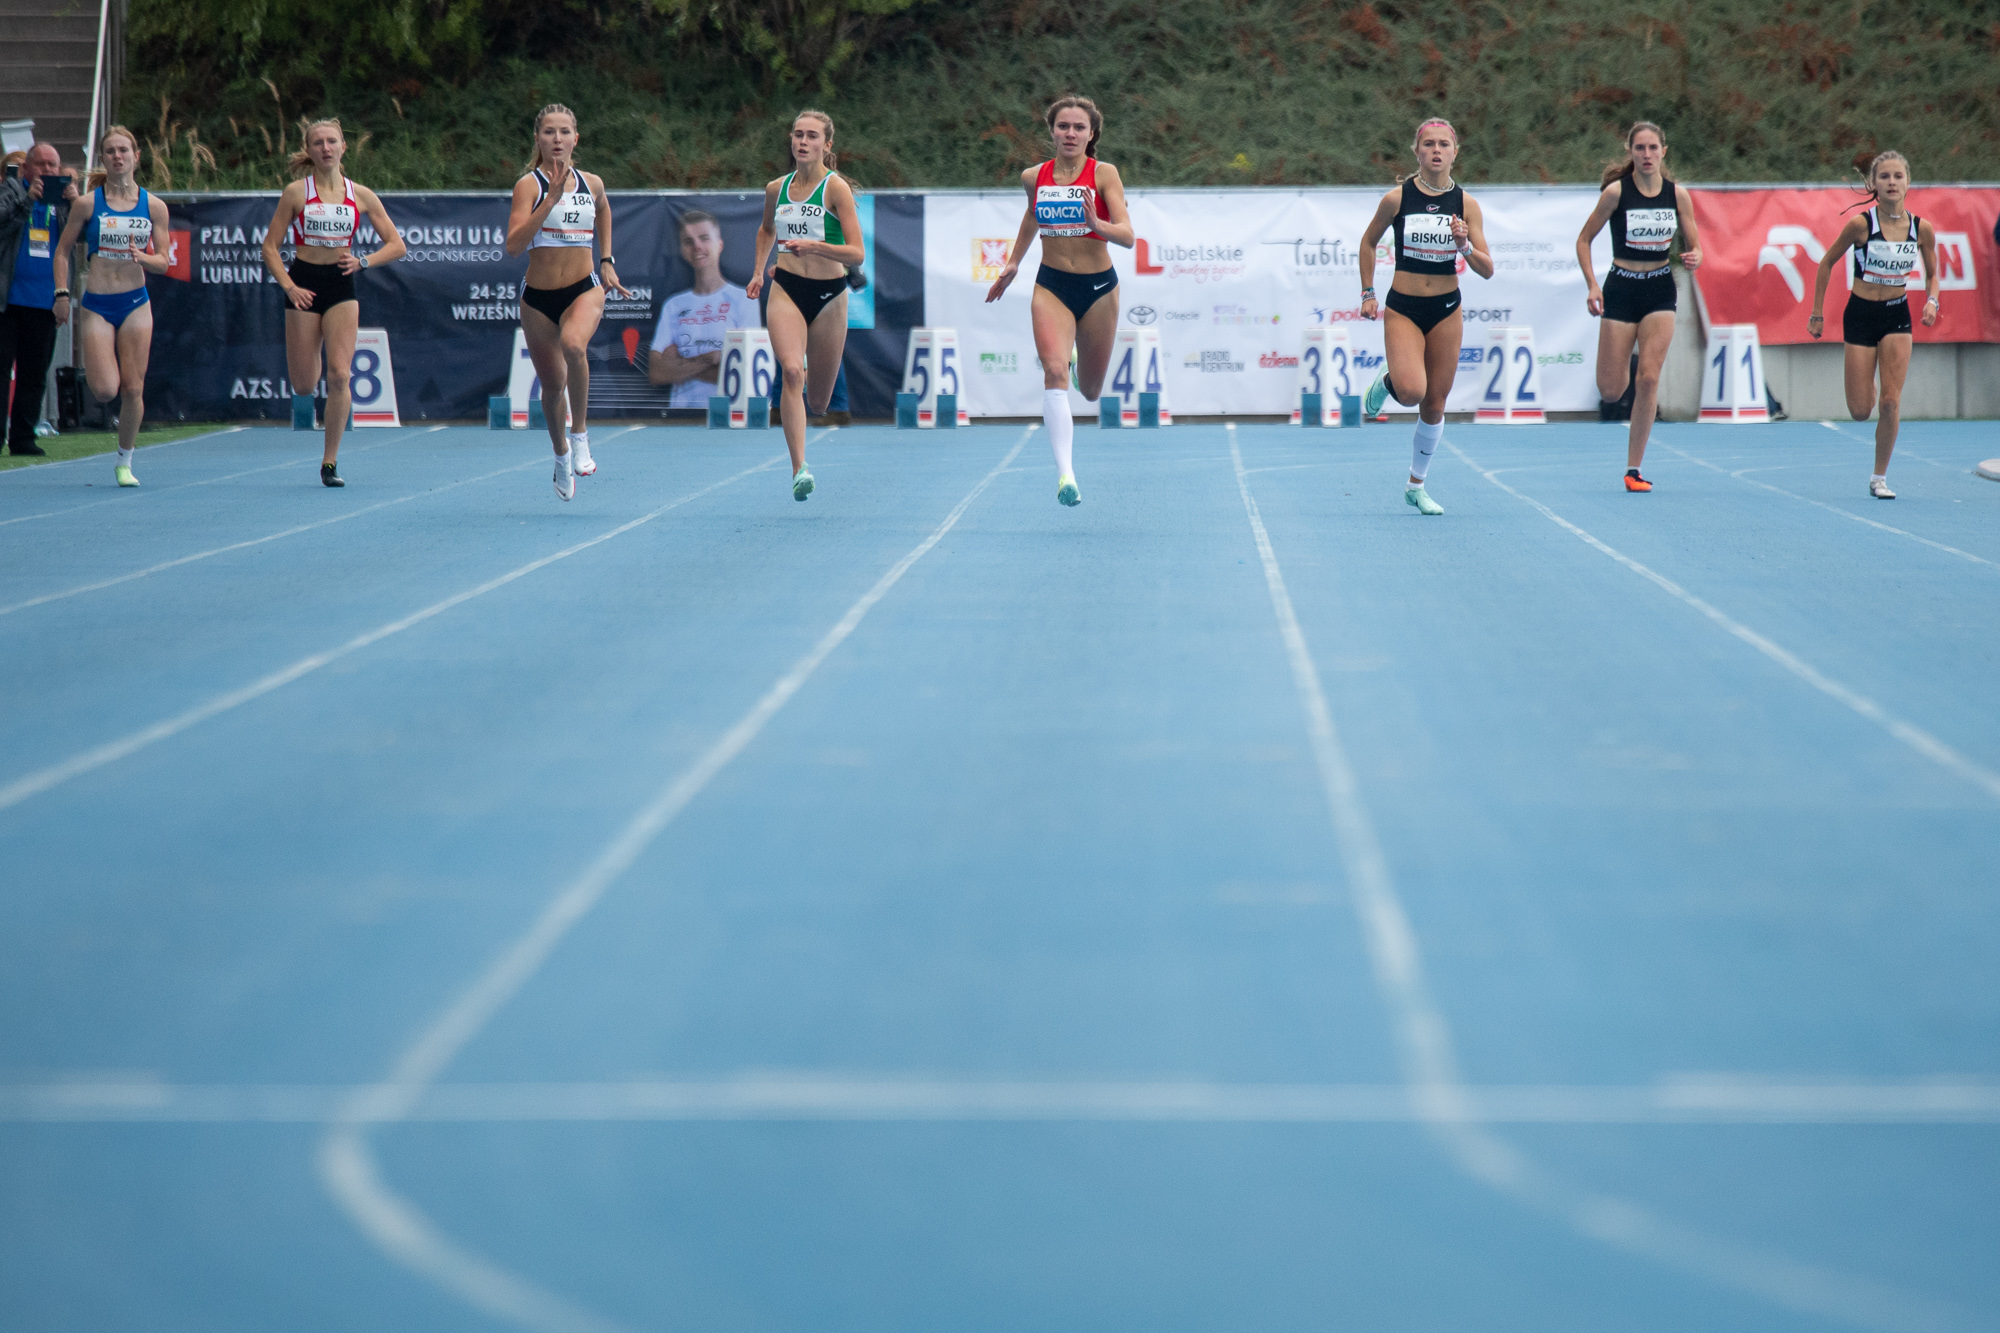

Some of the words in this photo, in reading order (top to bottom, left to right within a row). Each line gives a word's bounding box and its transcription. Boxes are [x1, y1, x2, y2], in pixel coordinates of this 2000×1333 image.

[572, 195, 591, 206] 184
[336, 206, 350, 216] 81
[562, 210, 580, 224] JEŻ
[801, 205, 822, 217] 950
[1037, 206, 1084, 219] TOMCZY
[1655, 211, 1674, 221] 338
[306, 219, 352, 232] ZBIELSKA
[787, 221, 808, 235] KUŚ
[1436, 216, 1451, 227] 71
[201, 225, 246, 245] PZLA
[468, 225, 505, 246] U16
[1069, 228, 1087, 236] 2022
[1411, 232, 1455, 245] BISKUP
[1631, 227, 1672, 237] CZAJKA
[201, 249, 241, 263] MAŁY
[399, 247, 503, 263] SOCIŃSKIEGO
[1895, 244, 1916, 254] 762
[1867, 258, 1914, 271] MOLENDA
[201, 265, 263, 284] LUBLIN
[1616, 268, 1646, 280] NIKE
[1647, 265, 1671, 280] PRO
[469, 283, 517, 300] 24-25
[350, 349, 382, 406] 8
[723, 348, 742, 404] 6
[752, 348, 772, 398] 6
[911, 348, 929, 405] 5
[940, 348, 958, 396] 5
[1112, 347, 1135, 404] 4
[1145, 347, 1162, 394] 4
[1301, 346, 1321, 395] 3
[1332, 346, 1350, 399] 3
[1484, 346, 1504, 402] 2
[1512, 346, 1536, 401] 2
[1712, 345, 1727, 402] 1
[1741, 344, 1756, 401] 1
